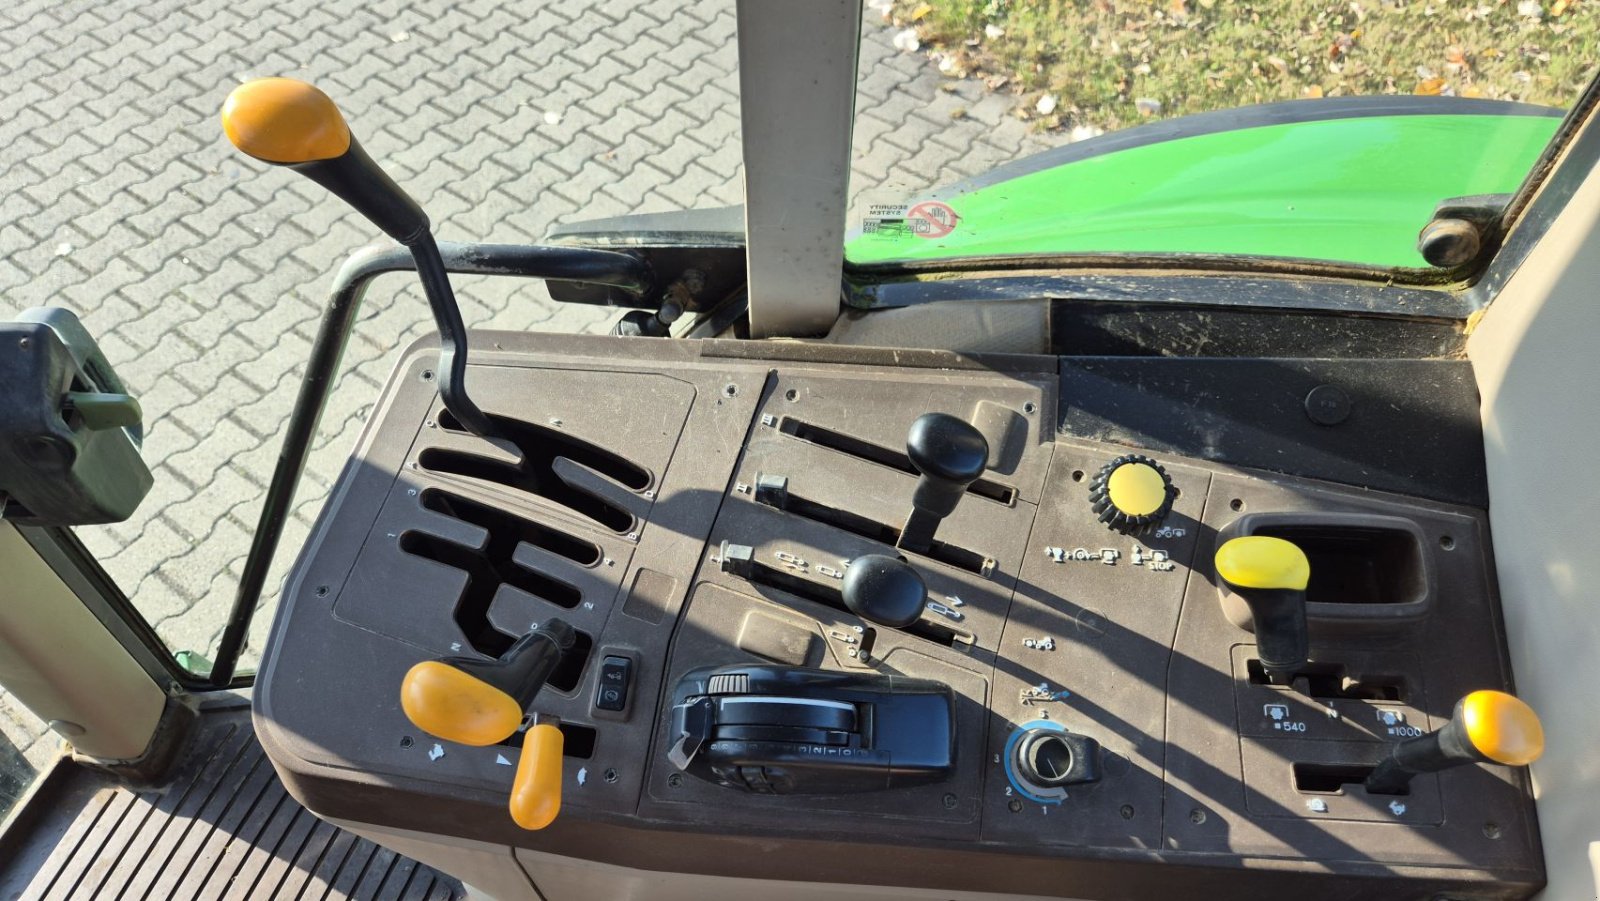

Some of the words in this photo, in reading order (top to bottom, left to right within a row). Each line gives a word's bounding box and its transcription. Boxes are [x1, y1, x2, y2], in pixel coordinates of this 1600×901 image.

[1148, 561, 1173, 571] STOP
[584, 602, 594, 610] 2
[450, 642, 462, 652] N
[1283, 722, 1306, 732] 540
[1395, 726, 1422, 737] 1000
[993, 754, 1000, 764] 3
[1005, 786, 1012, 796] 2
[1042, 805, 1047, 815] 1
